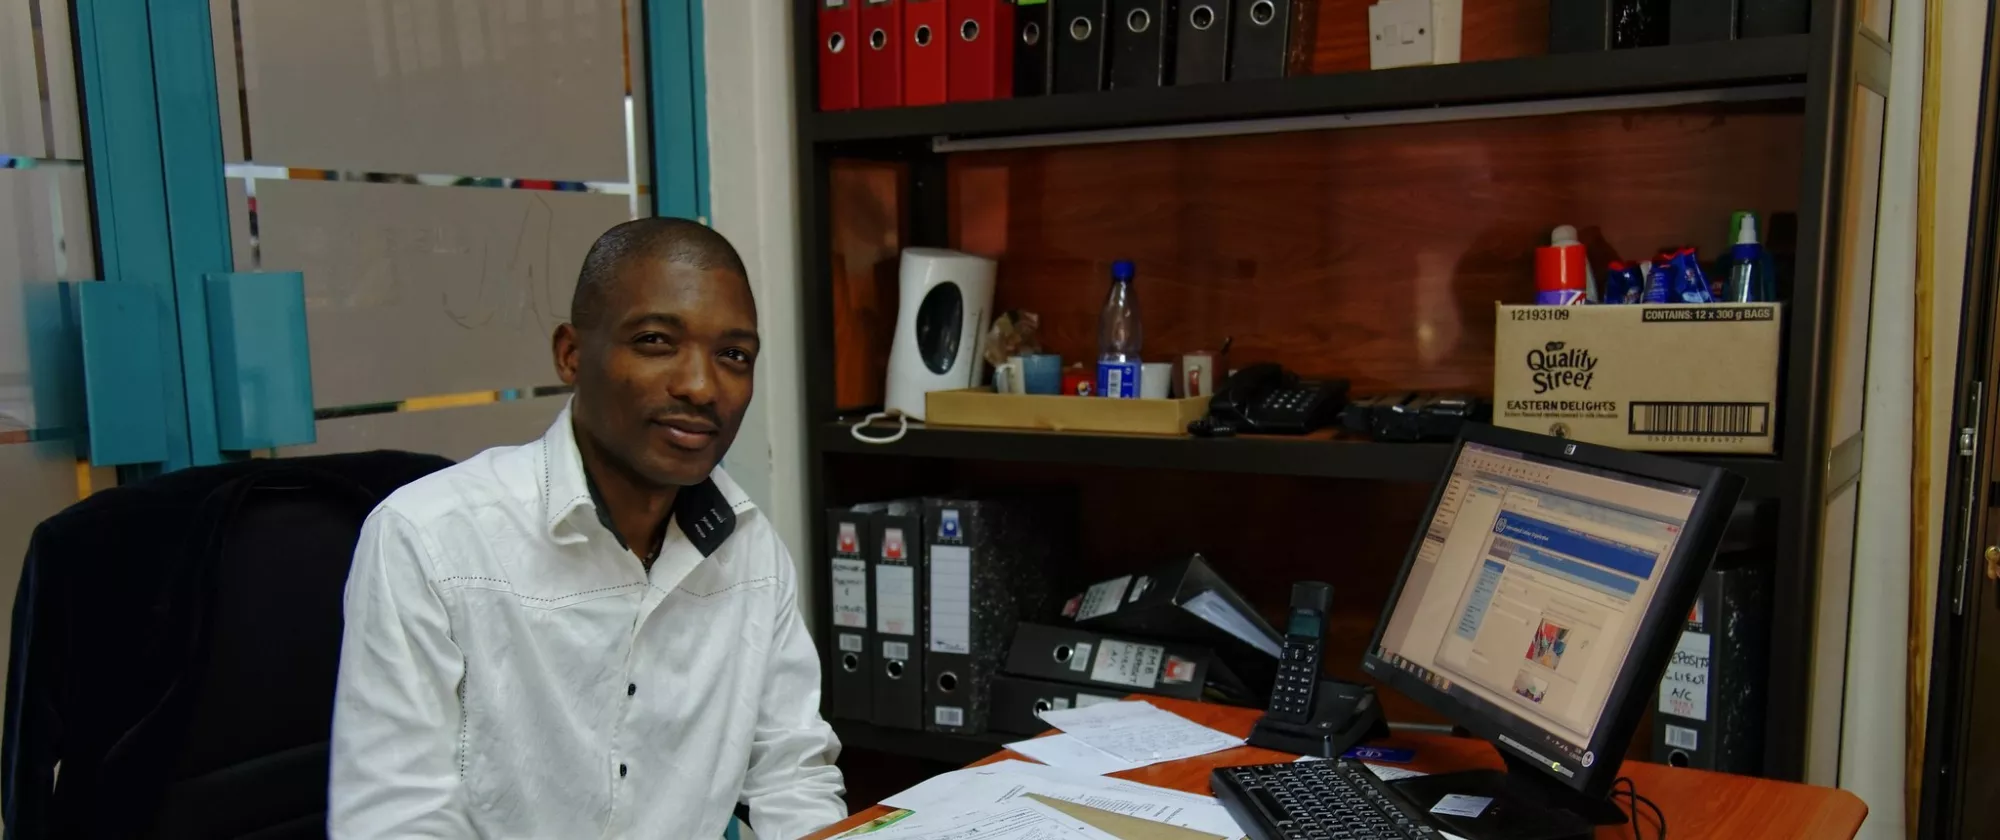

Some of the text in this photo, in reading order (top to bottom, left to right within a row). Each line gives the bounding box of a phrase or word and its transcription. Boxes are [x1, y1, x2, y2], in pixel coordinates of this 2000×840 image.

[1510, 309, 1570, 321] 12193109
[1645, 309, 1693, 320] CONTAINS:
[1695, 309, 1706, 320] 12
[1716, 309, 1734, 319] 300
[1744, 308, 1770, 319] BAGS
[1526, 348, 1598, 372] Quality
[1532, 370, 1594, 394] Street
[1506, 400, 1616, 411] EASTERN DELIGHTS
[1671, 687, 1692, 701] A/C
